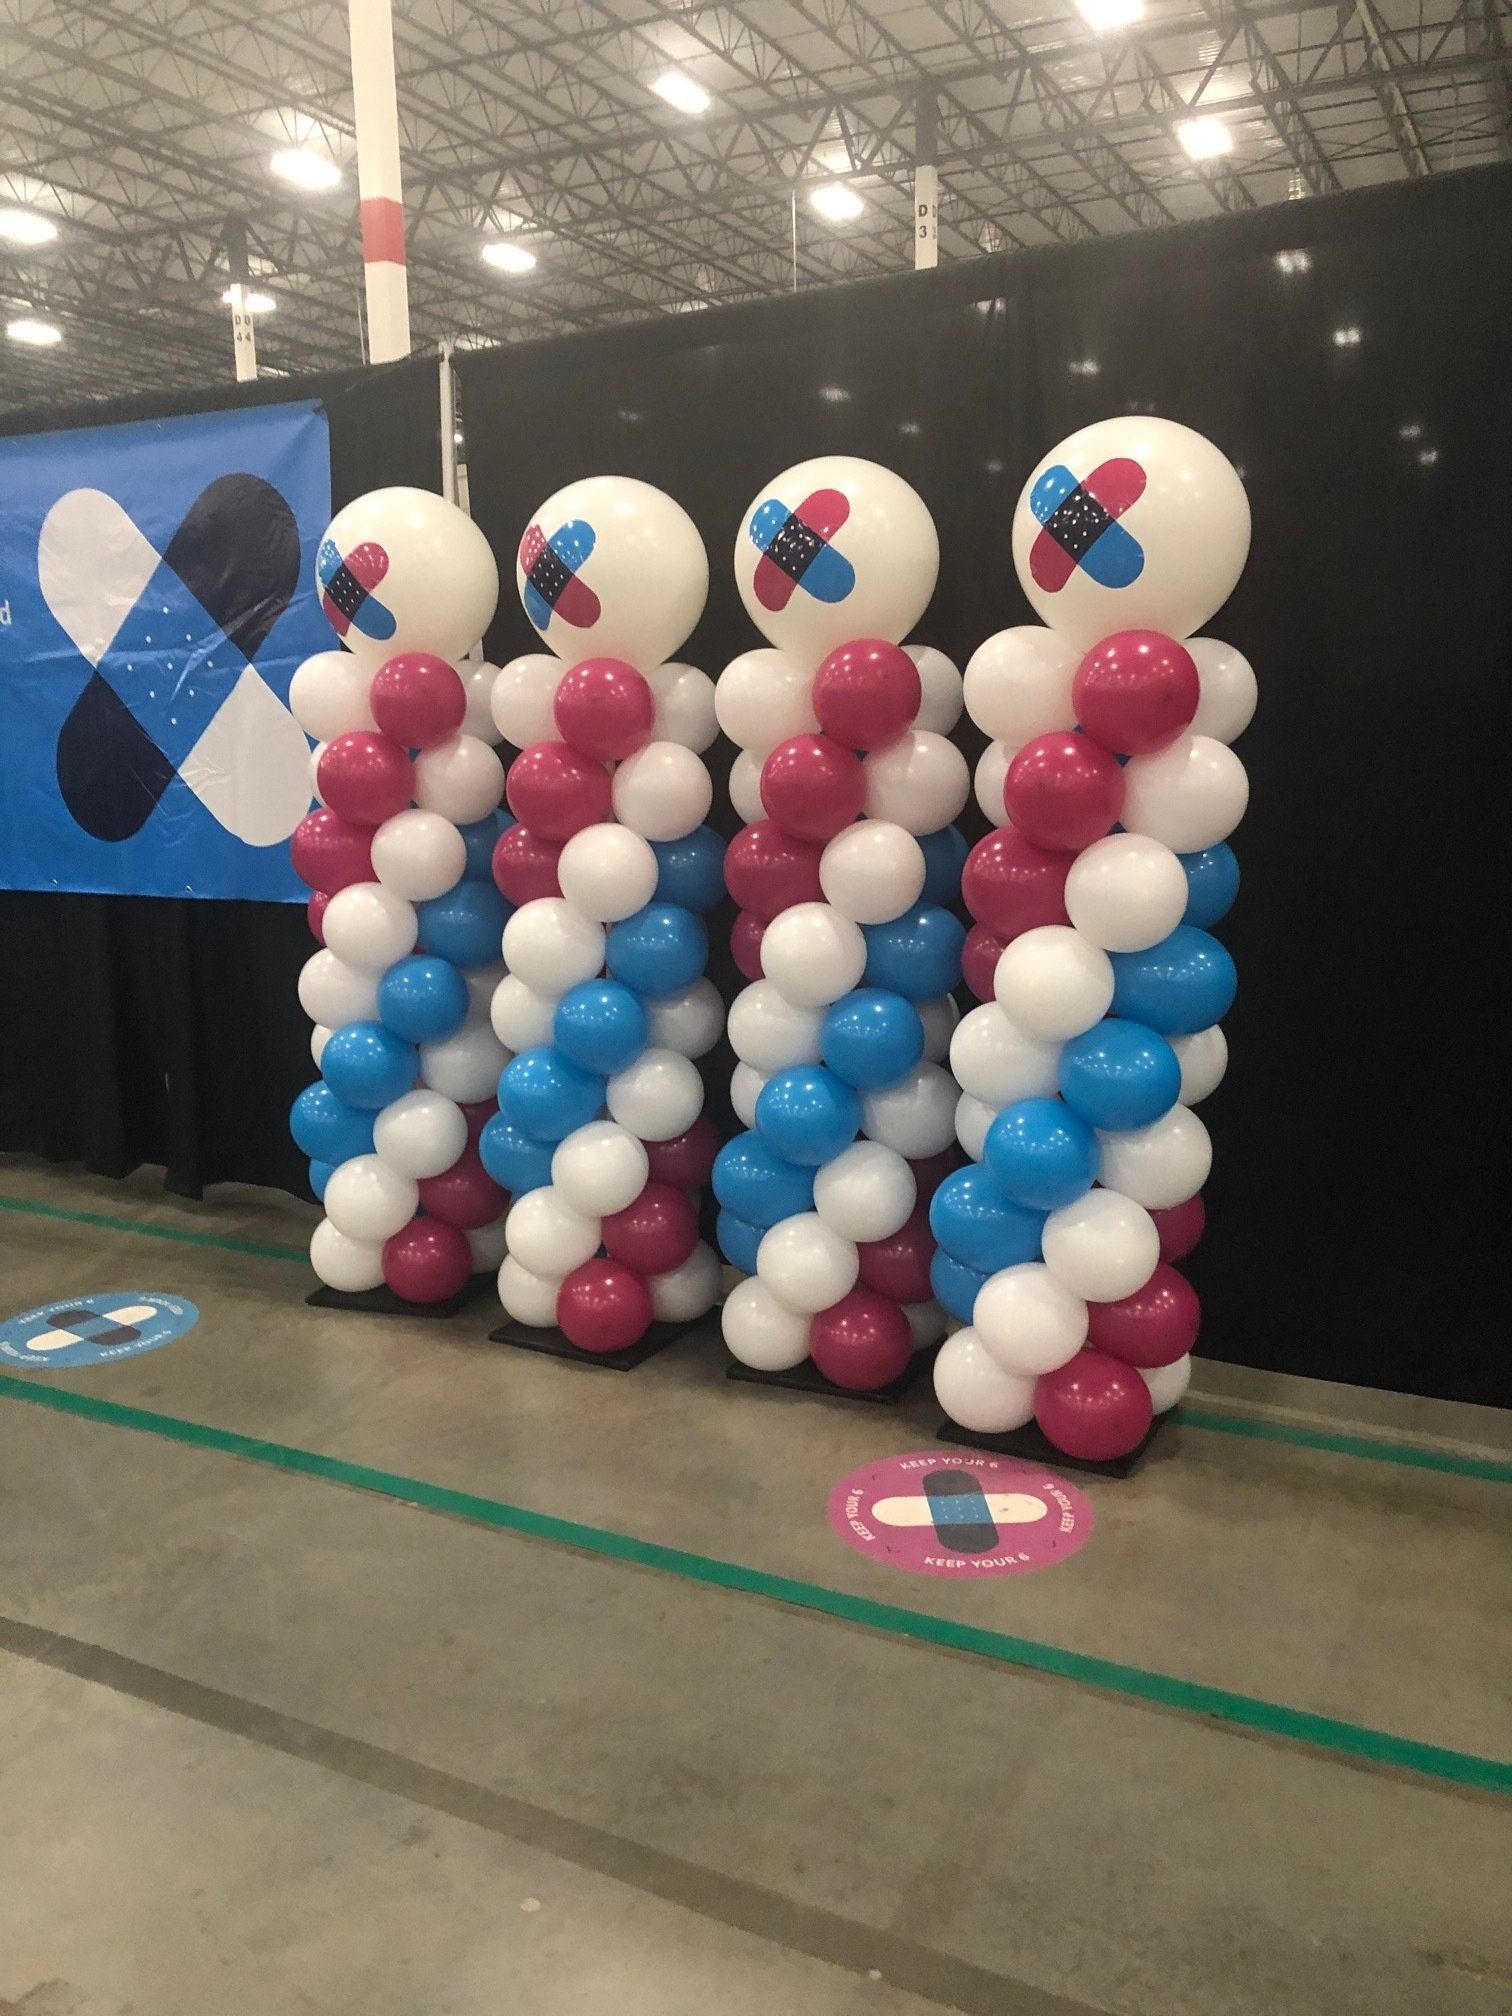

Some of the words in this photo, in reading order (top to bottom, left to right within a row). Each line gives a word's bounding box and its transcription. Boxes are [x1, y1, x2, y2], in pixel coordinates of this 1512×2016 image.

[918, 204, 928, 217] D
[919, 225, 927, 238] 3
[899, 1458, 937, 1470] KEEP
[942, 1457, 985, 1466] YOUR
[845, 1495, 861, 1519] YOUR
[849, 1520, 876, 1542] KEEP
[924, 1556, 966, 1568] KEEP
[971, 1556, 1018, 1568] YOUR
[1018, 1552, 1030, 1561] 6
